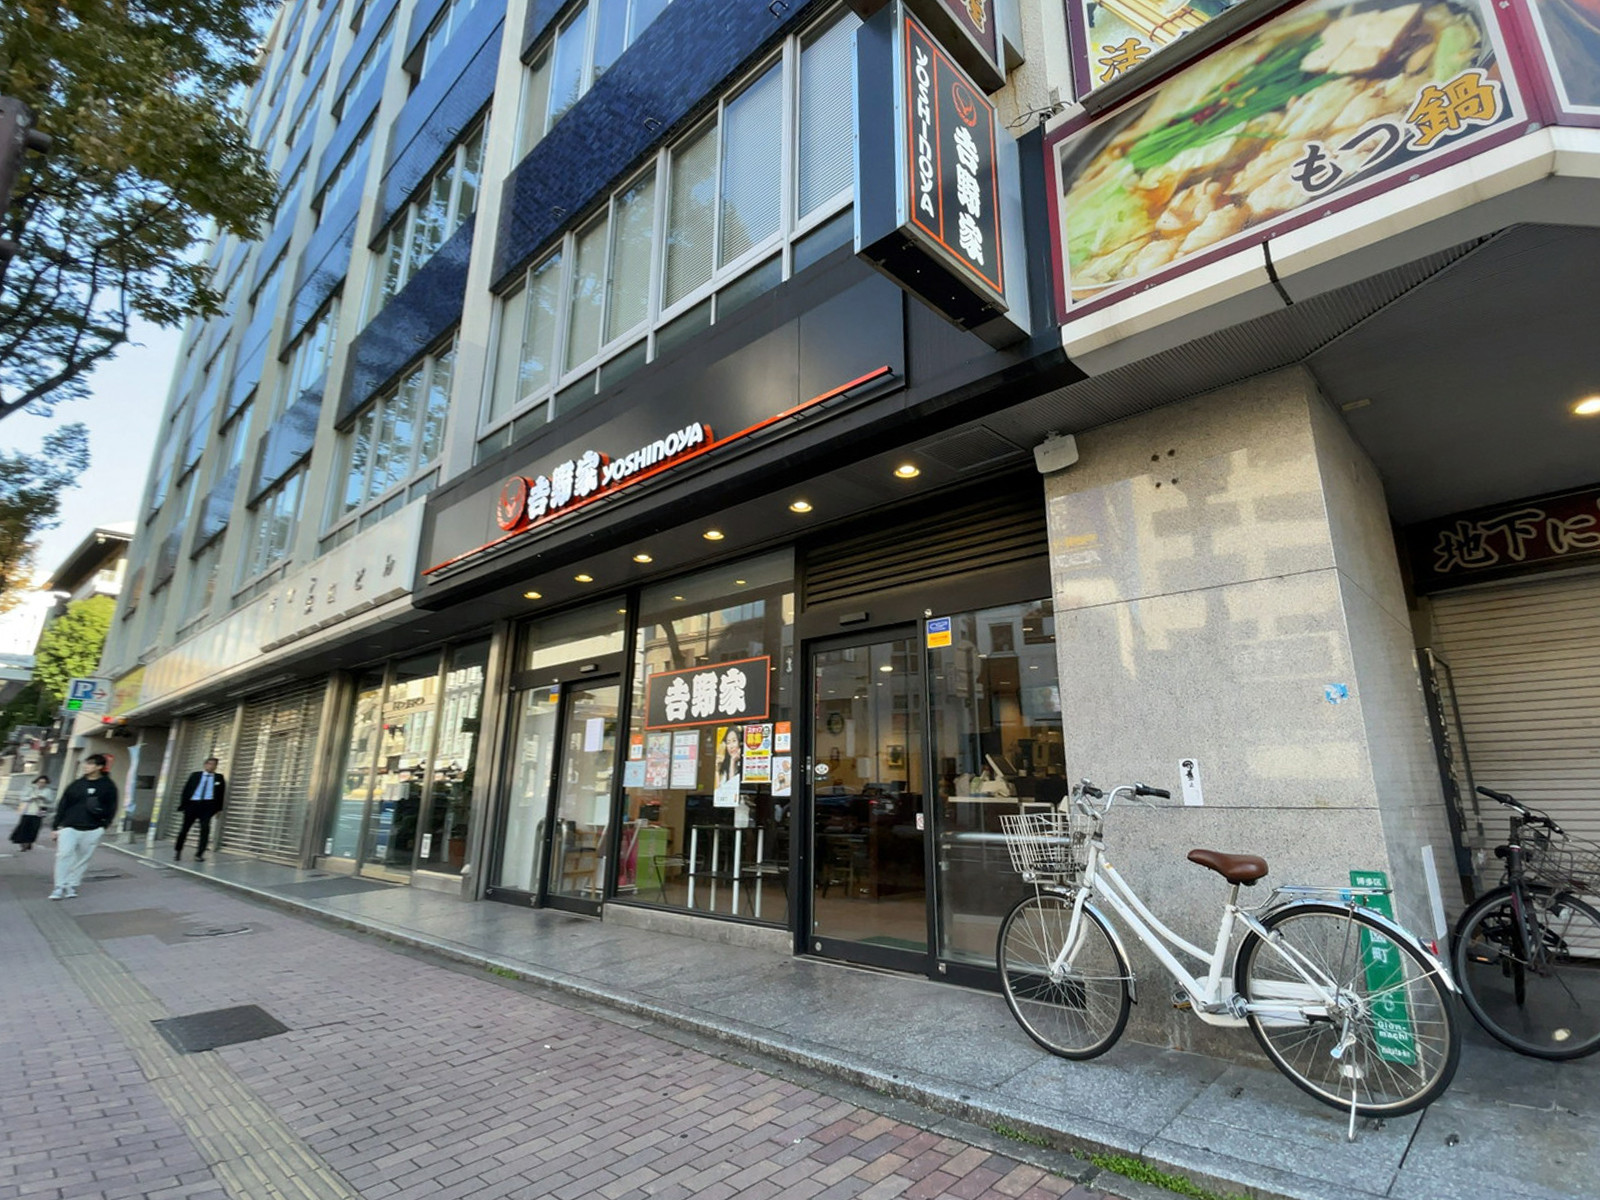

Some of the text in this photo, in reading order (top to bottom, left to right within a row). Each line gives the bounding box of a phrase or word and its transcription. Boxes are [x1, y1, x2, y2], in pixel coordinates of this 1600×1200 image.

[915, 46, 935, 219] YOSHINOYA
[1291, 73, 1496, 192] もつ鍋
[601, 422, 704, 486] YOSHINOYA
